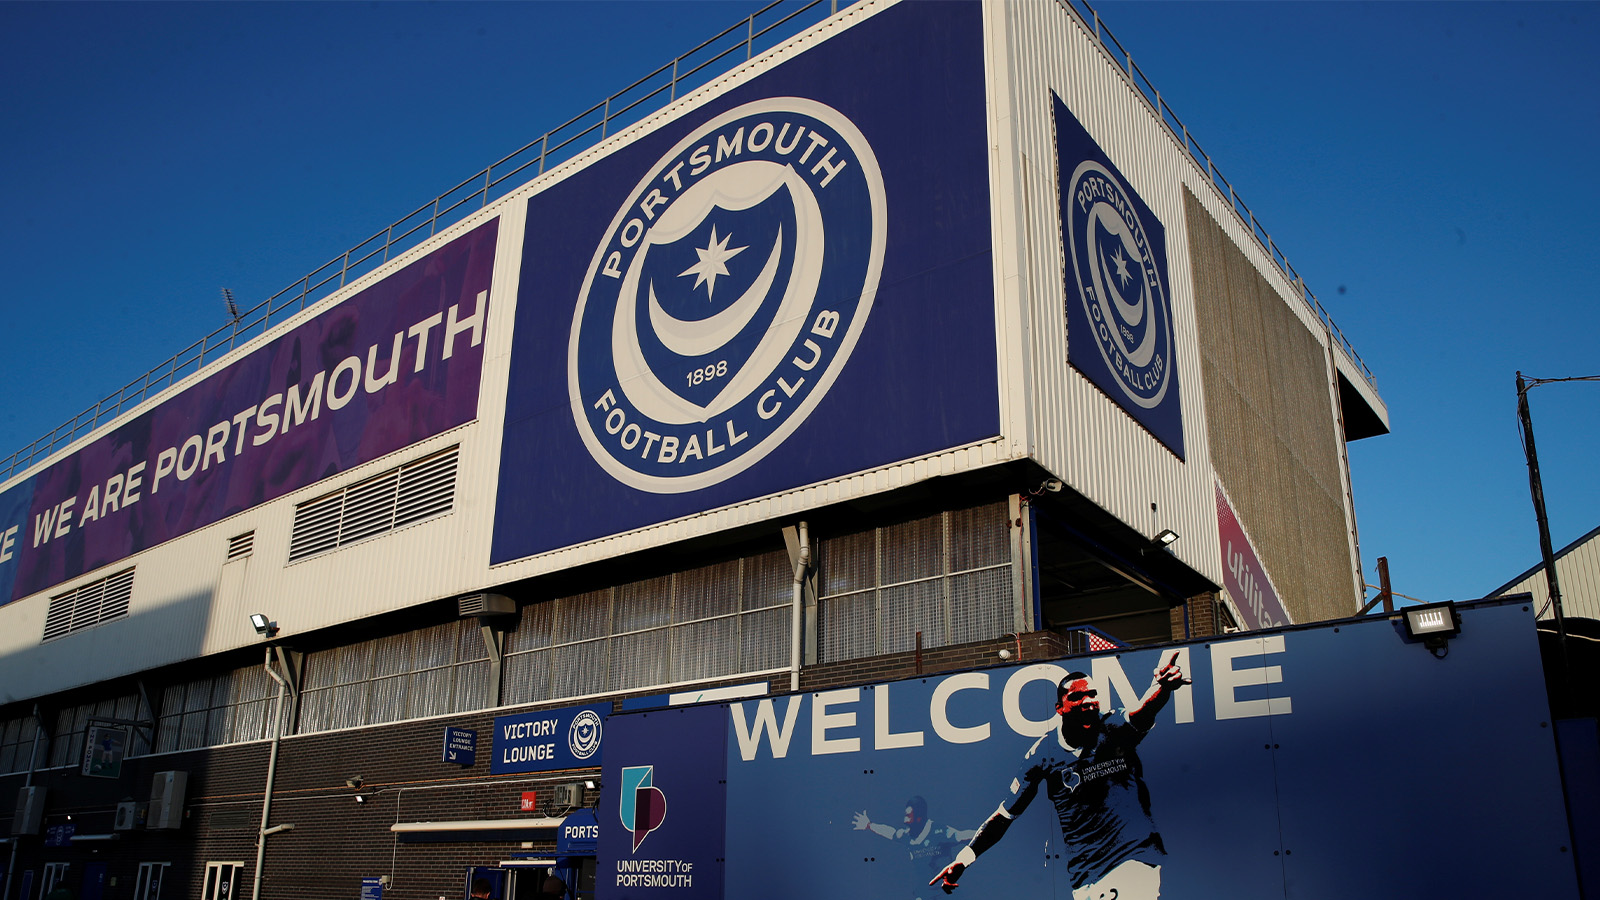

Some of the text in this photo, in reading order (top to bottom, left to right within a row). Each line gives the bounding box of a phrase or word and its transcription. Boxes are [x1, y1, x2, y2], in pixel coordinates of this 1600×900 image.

[602, 122, 847, 279] PORTSMOUTH
[1078, 177, 1157, 287] PORTSMOUTH
[1086, 286, 1163, 390] FOOTBALL CLUB
[686, 361, 728, 387] 1898
[594, 309, 840, 464] FOOTBALL CLUB
[0, 290, 487, 564] E WE ARE PORTSMOUTH
[730, 635, 1292, 761] WELCOME
[504, 719, 558, 740] VICTORY
[572, 713, 600, 730] PORTSMOUTH
[449, 743, 474, 751] ENTRANCE
[503, 743, 555, 763] LOUNGE
[1082, 759, 1119, 775] UNIVERSITY
[1083, 763, 1127, 782] PORTSMOUTH
[564, 825, 599, 839] PORTS
[616, 860, 693, 873] UNIVERSITY OF
[616, 874, 692, 888] PORTSMOUTH
